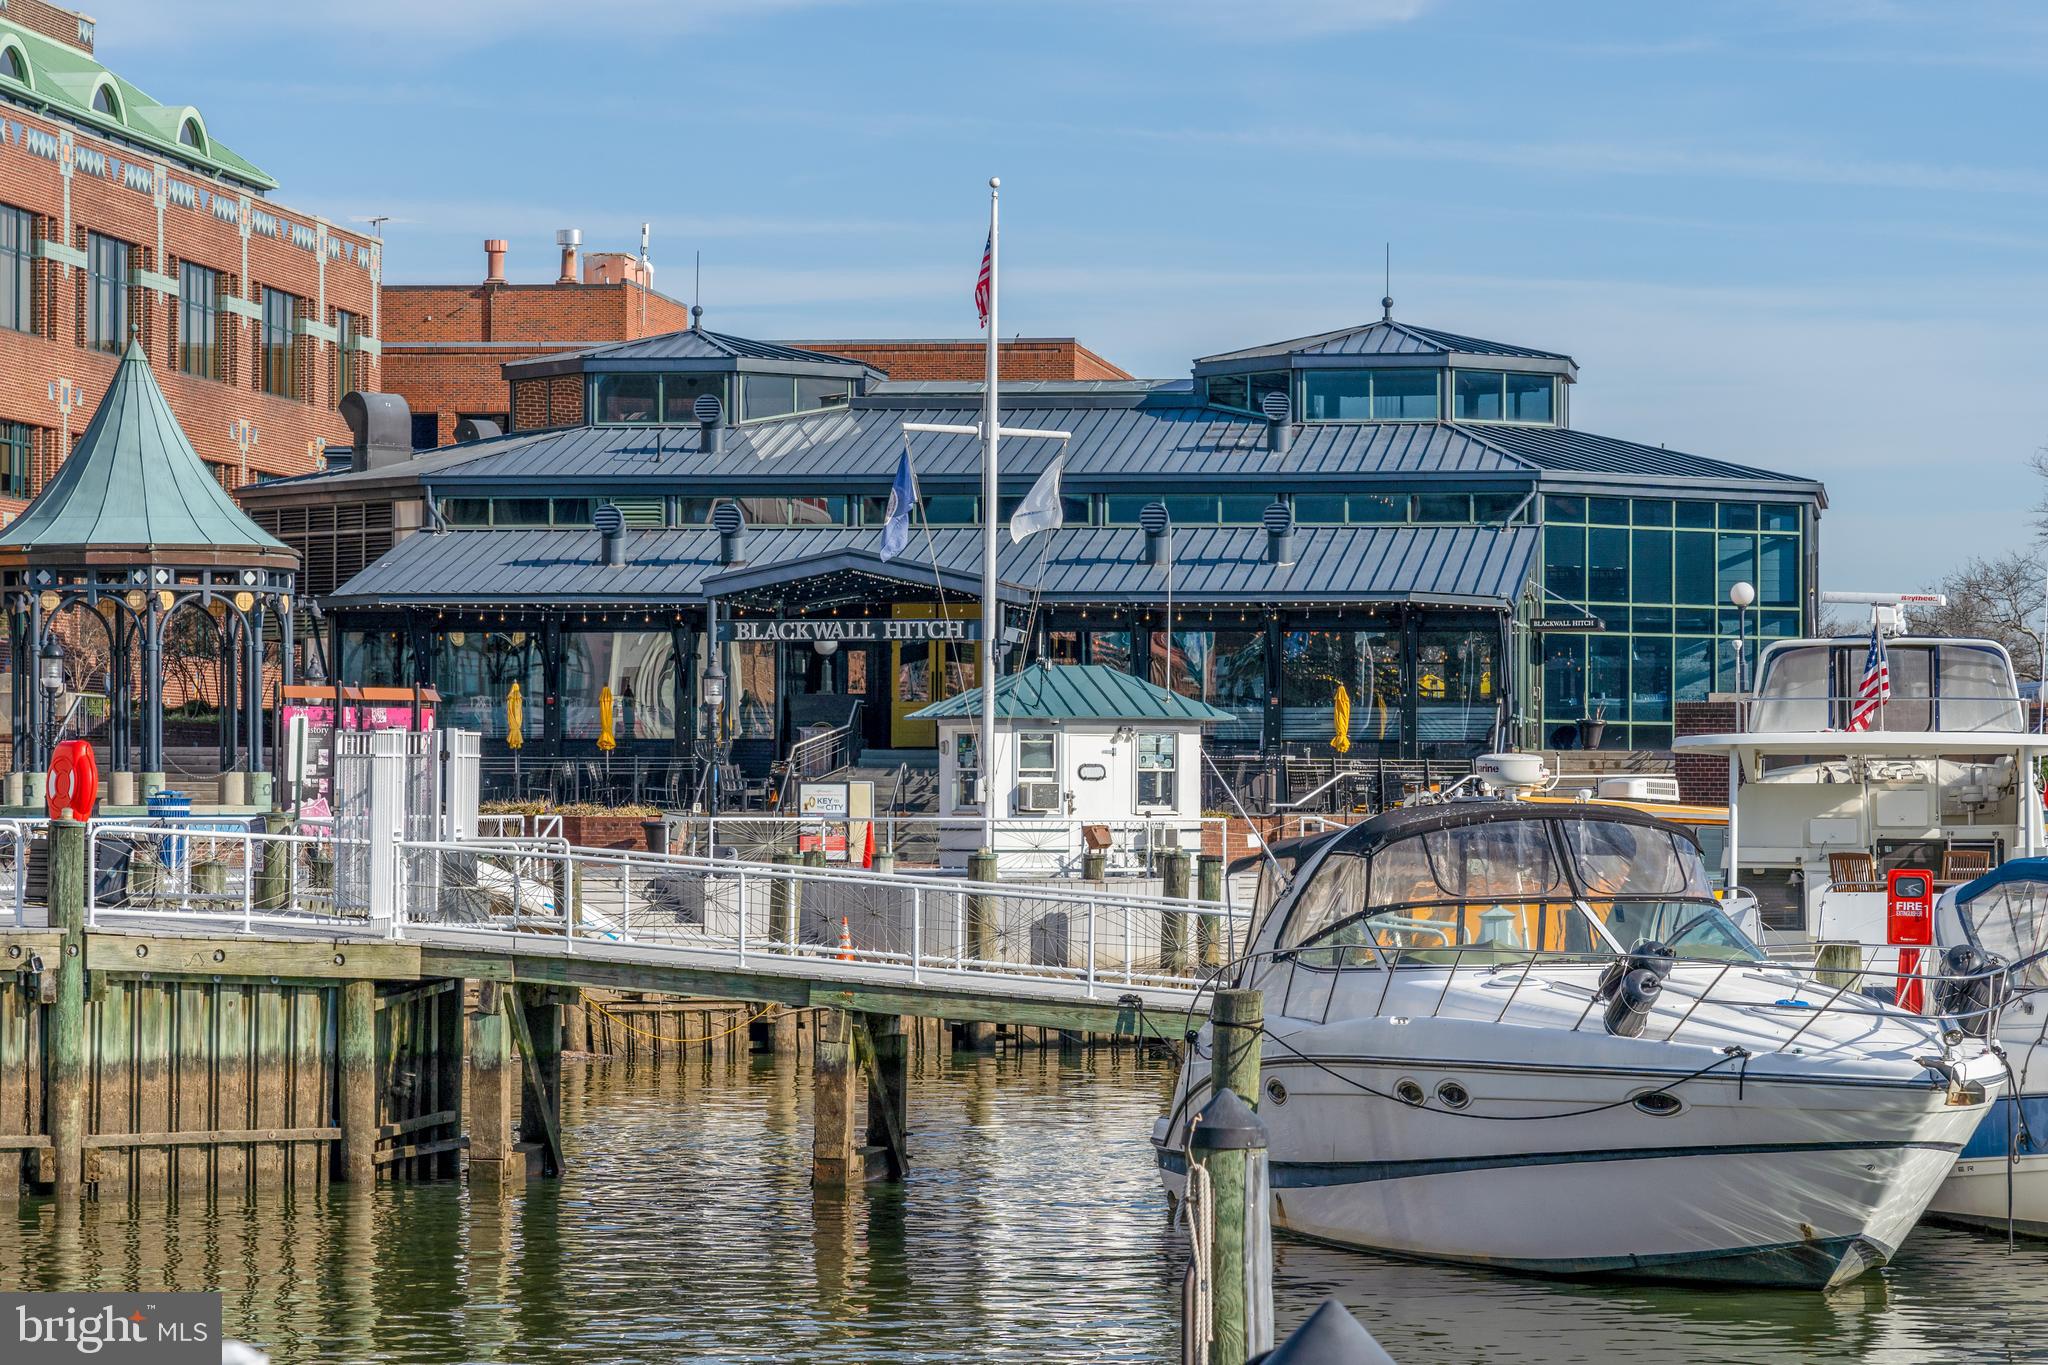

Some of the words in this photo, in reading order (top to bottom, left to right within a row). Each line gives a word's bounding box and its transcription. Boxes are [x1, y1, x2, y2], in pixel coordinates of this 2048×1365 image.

[734, 621, 876, 640] BLACKWALL
[883, 620, 965, 639] HITCH
[817, 797, 833, 805] KEY
[1896, 901, 1922, 911] FIRE
